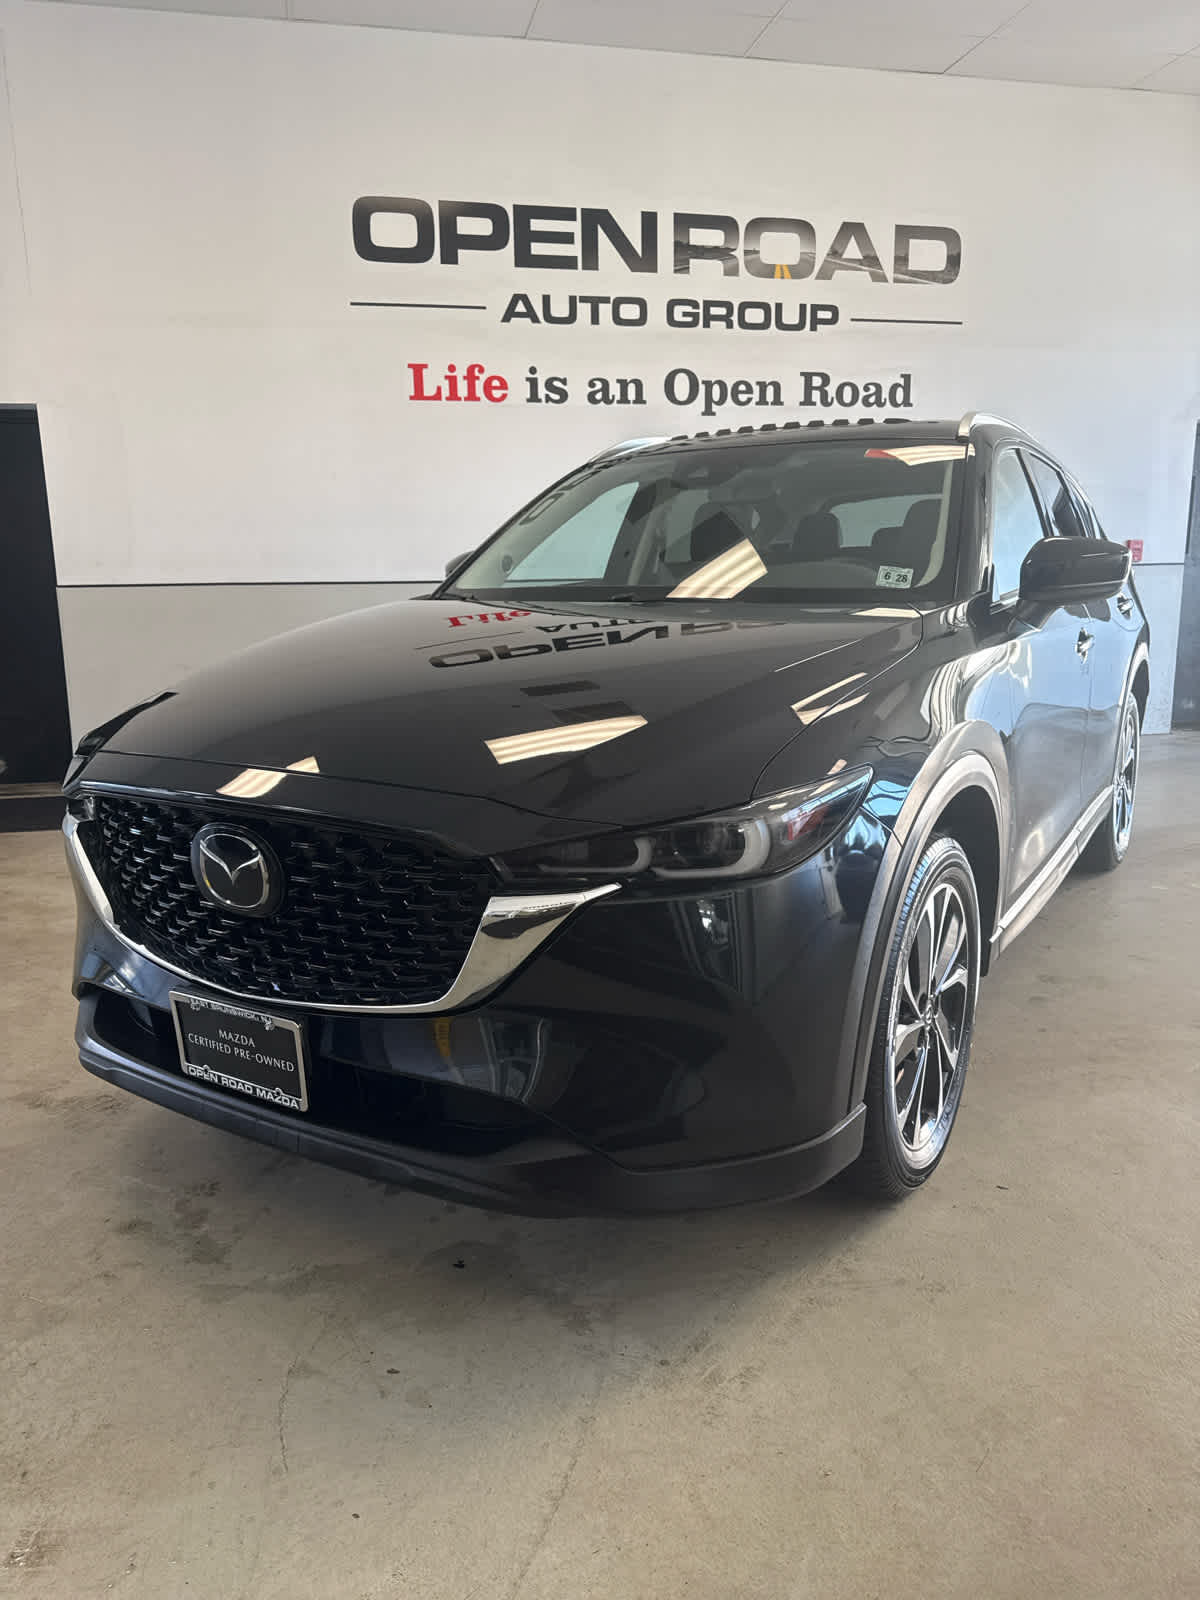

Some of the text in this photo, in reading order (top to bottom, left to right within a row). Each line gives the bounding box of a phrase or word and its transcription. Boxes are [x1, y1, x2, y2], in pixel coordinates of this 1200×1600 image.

[352, 195, 962, 285] OPEN ROAD
[501, 293, 839, 332] AUTO GROUP
[407, 363, 914, 416] Life is an Open Road
[884, 571, 908, 583] 6 28
[188, 1032, 295, 1073] CERTIFIED PRE-OWNED
[219, 1029, 256, 1048] MAZDA
[188, 1066, 299, 1110] OPEN ROAD MAZDA
